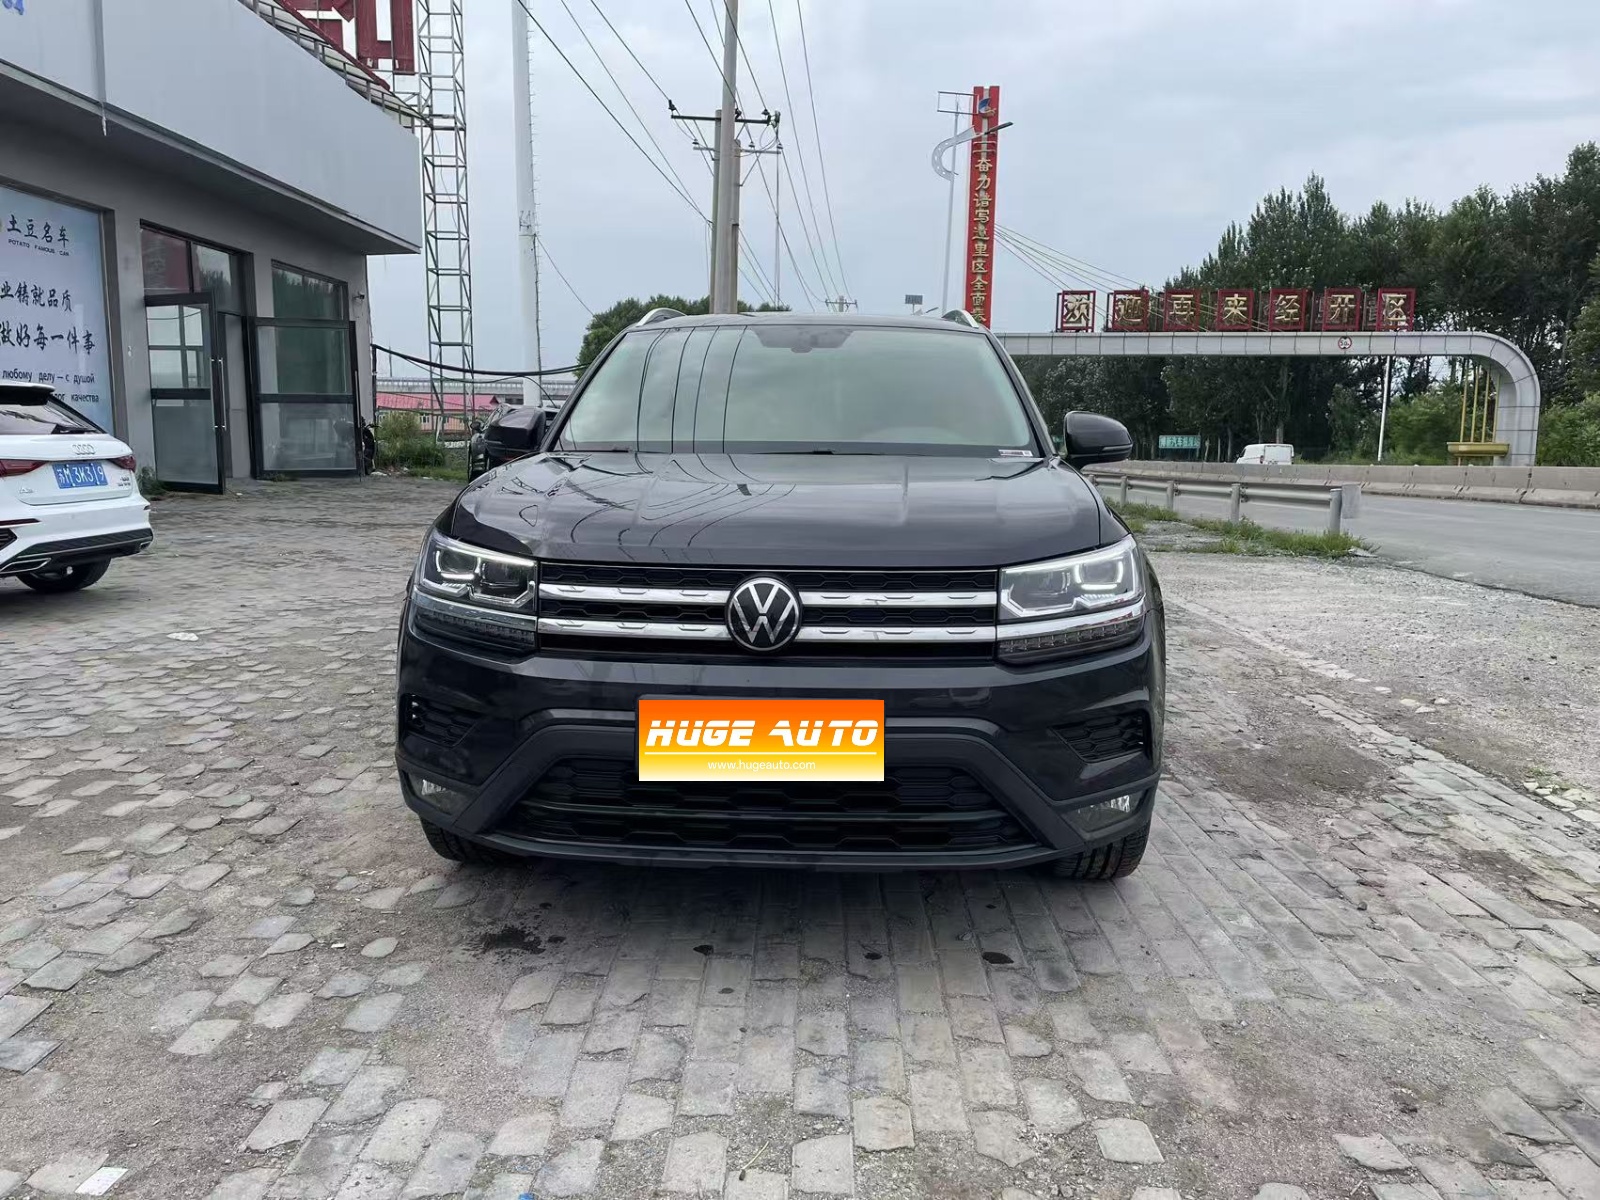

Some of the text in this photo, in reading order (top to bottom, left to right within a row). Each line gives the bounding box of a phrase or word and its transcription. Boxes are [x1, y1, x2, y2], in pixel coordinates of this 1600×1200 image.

[7, 213, 69, 248] 土豆名车
[8, 238, 30, 248] POTATO
[34, 244, 56, 253] FAMOUS
[0, 280, 73, 312] 业铸就品质
[2, 368, 32, 382] любому
[38, 372, 55, 384] делу
[73, 373, 95, 386] душой
[71, 393, 99, 402] качества
